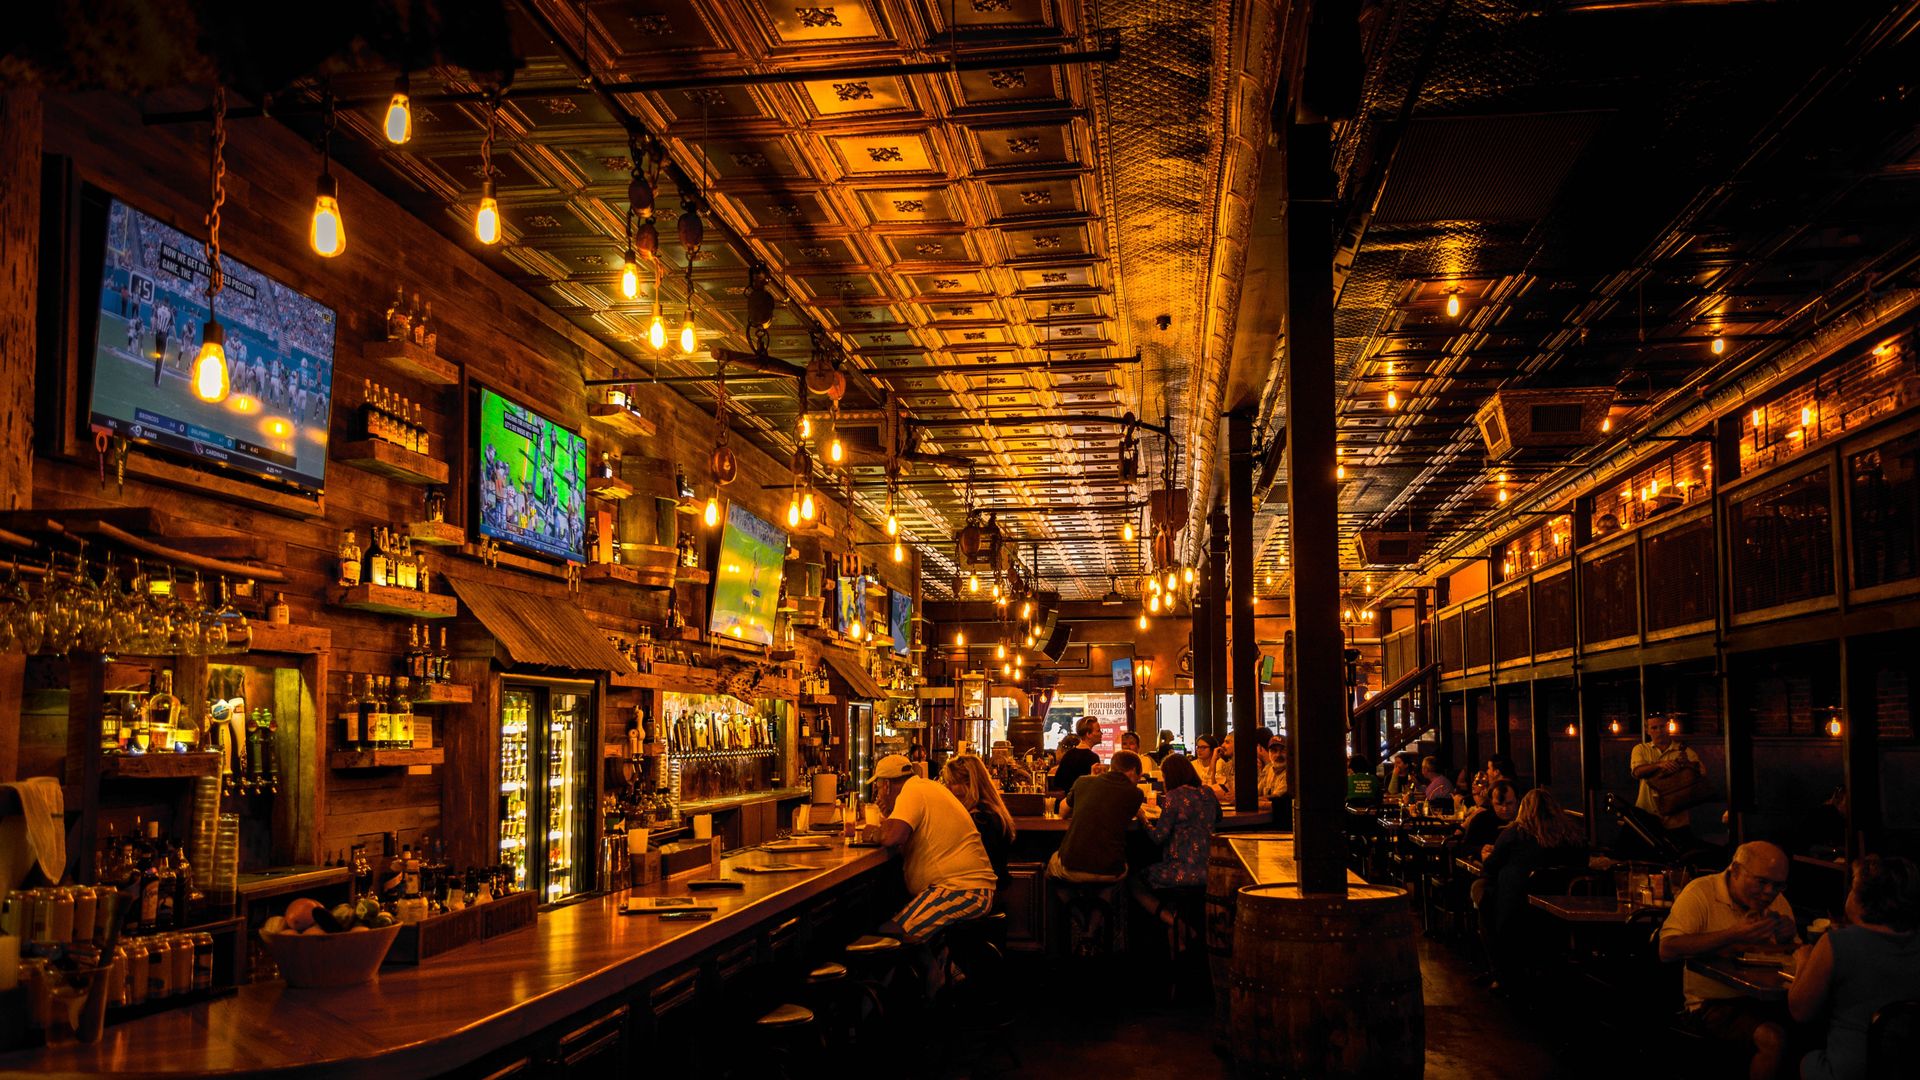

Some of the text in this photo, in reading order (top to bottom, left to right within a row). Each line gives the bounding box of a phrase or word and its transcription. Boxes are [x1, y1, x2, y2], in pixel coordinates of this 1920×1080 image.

[163, 245, 176, 260] NOW
[177, 252, 187, 264] WE
[187, 256, 198, 269] GET
[198, 261, 205, 273] IN
[231, 277, 255, 297] POSITION
[180, 267, 192, 280] THE
[143, 430, 157, 440] RAMS
[205, 448, 228, 460] CARDINALS
